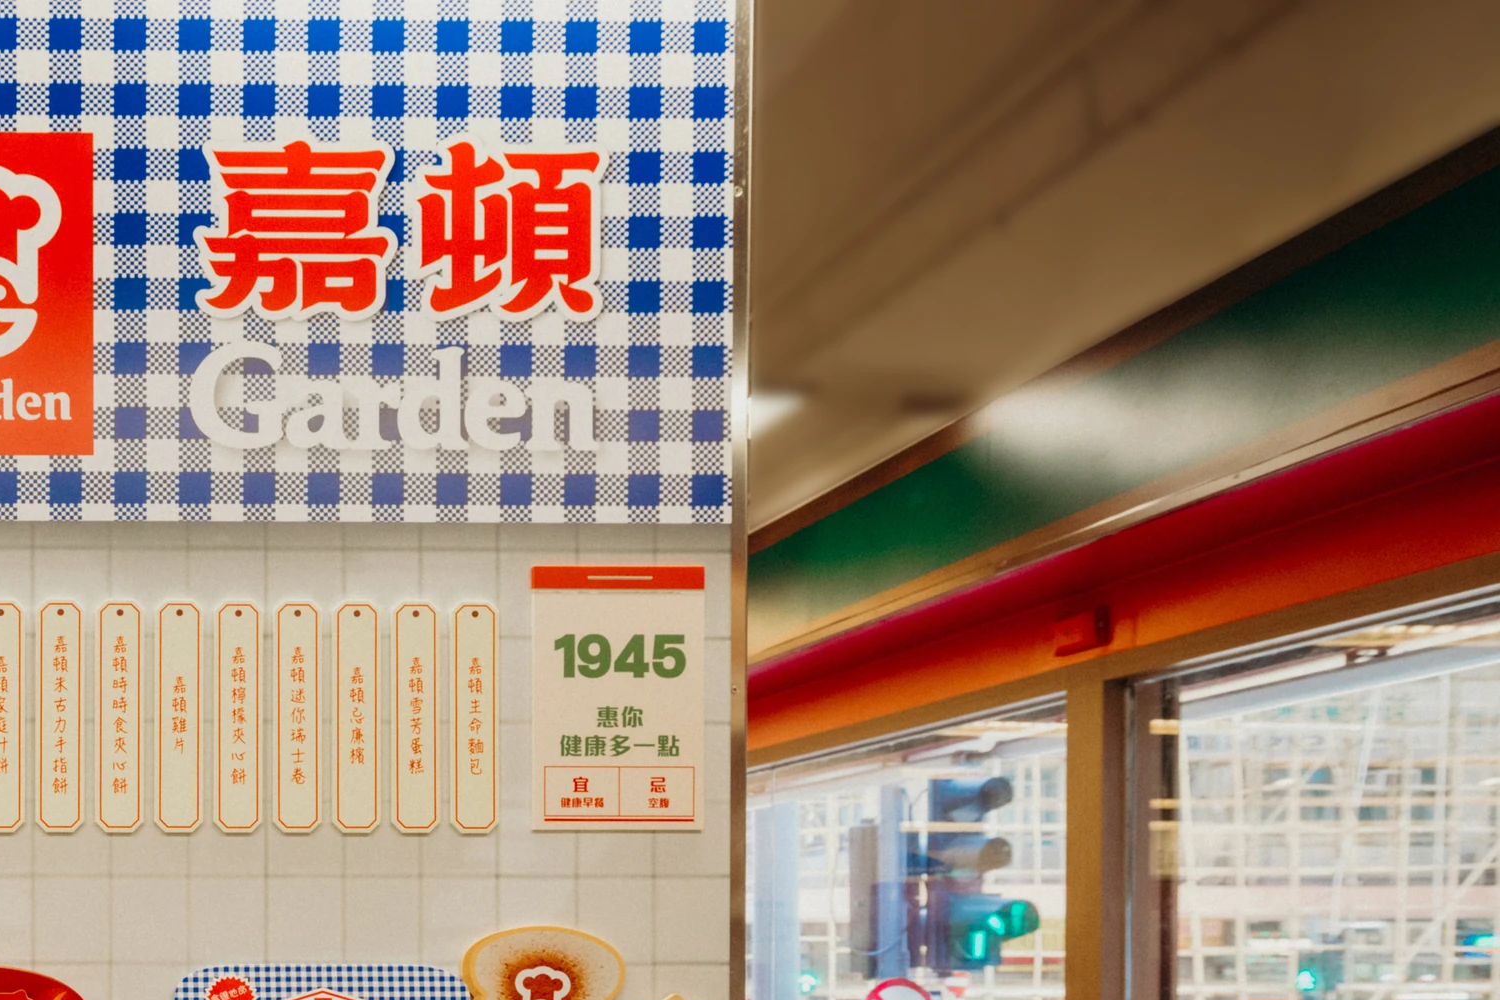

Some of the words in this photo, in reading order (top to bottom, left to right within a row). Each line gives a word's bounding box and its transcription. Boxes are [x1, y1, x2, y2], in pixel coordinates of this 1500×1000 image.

[198, 138, 609, 316] 嘉頓
[190, 339, 600, 453] Garden
[554, 633, 687, 679] 1945
[52, 635, 69, 795] 嘉頓朱古力手指餅
[111, 635, 128, 795] 嘉頓時時食夾心餅
[408, 656, 425, 775] 嘉頓雪芳蛋糕
[559, 734, 680, 757] 健康多一點
[596, 705, 644, 728] 惠你
[573, 776, 589, 793] 宜
[650, 776, 666, 793] 忌
